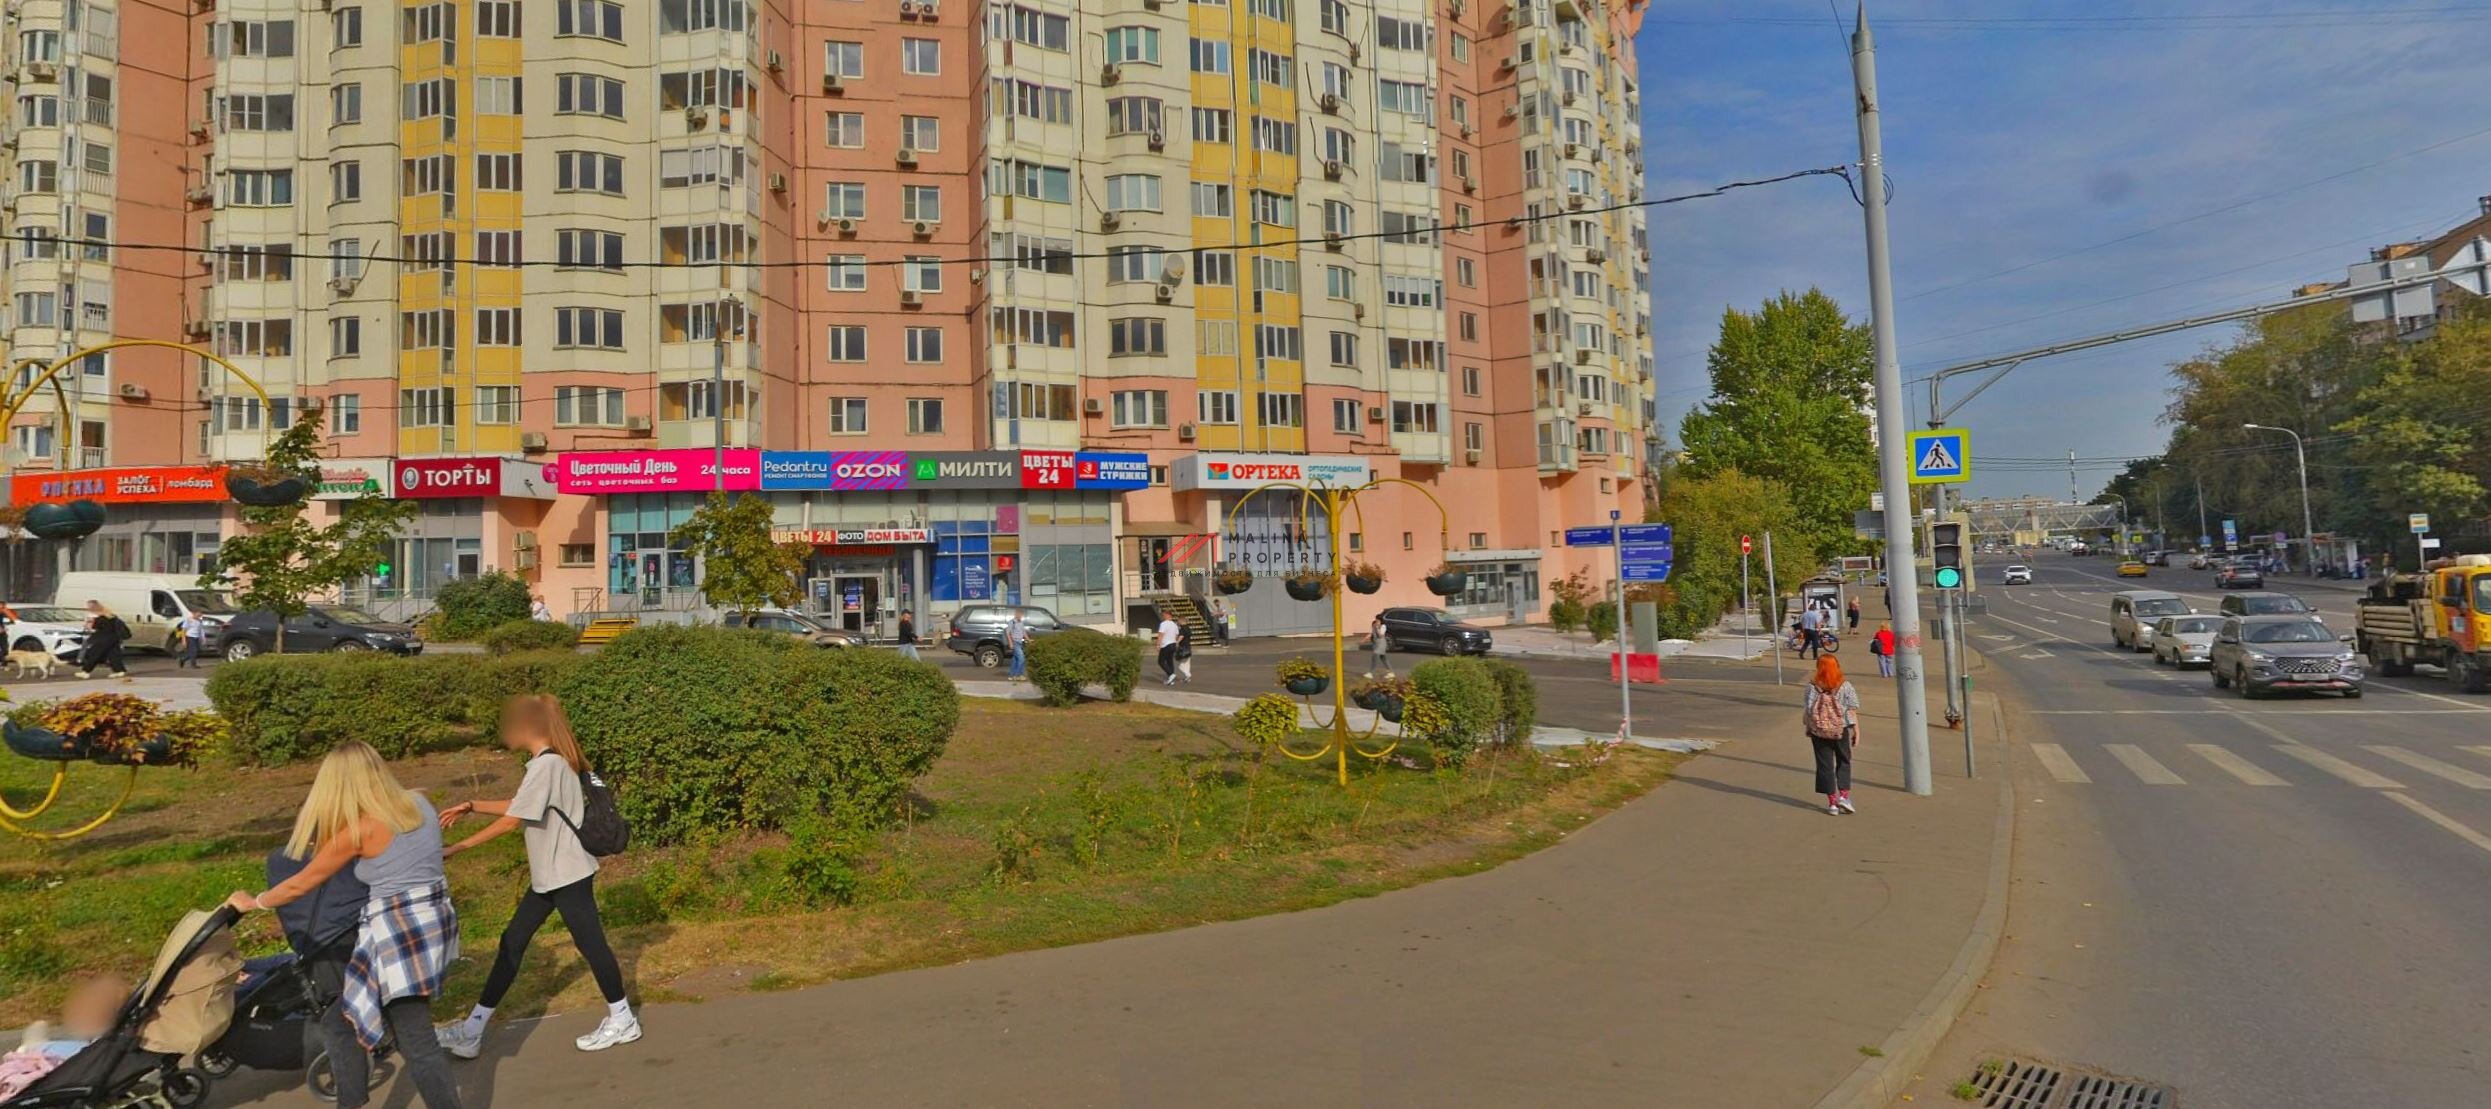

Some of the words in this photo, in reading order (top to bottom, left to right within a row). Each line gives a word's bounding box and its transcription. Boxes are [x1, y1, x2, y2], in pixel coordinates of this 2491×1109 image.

[570, 460, 640, 477] Цветочный
[644, 459, 678, 475] День
[764, 460, 828, 472] Pedant.ru
[1023, 455, 1074, 470] ЦВЕТЫ
[1100, 461, 1147, 471] МУЖСКИЕ
[700, 465, 717, 475] 24
[721, 466, 751, 475] часа
[837, 463, 901, 478] OZON
[939, 461, 1013, 478] МИЛТИ
[1100, 471, 1148, 480] СТРИЖКИ
[1232, 464, 1301, 480] ОРТЕКА
[168, 477, 214, 489] ломбард
[424, 467, 491, 487] ТОРТЫ
[1038, 469, 1060, 484] 24
[771, 531, 812, 544] ЦВЕТЫ
[816, 531, 832, 542] 24
[838, 532, 864, 541] ФОТО
[867, 531, 891, 542] ДОМ
[894, 530, 926, 541] БЫТА
